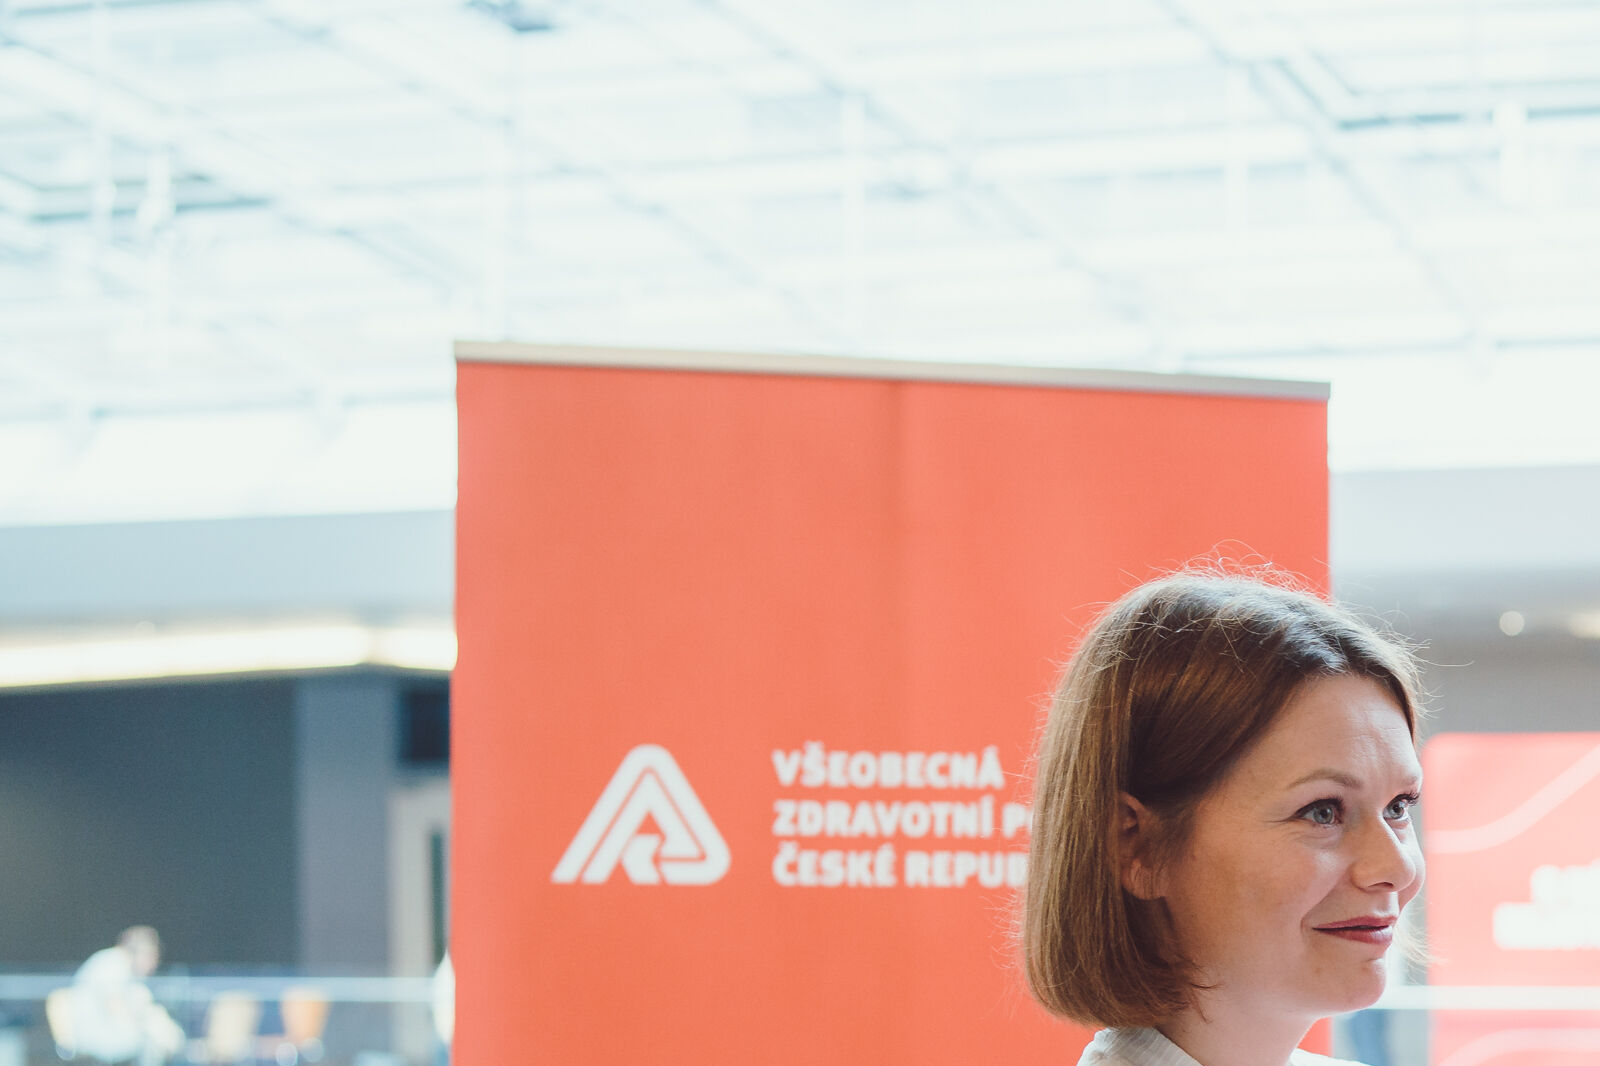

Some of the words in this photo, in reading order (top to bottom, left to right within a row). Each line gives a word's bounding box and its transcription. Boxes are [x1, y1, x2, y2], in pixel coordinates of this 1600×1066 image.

[772, 741, 1004, 788] VŠEOBECNÁ
[772, 793, 992, 838] ZDRAVOTNÍ
[772, 841, 895, 887] ČESKÉ
